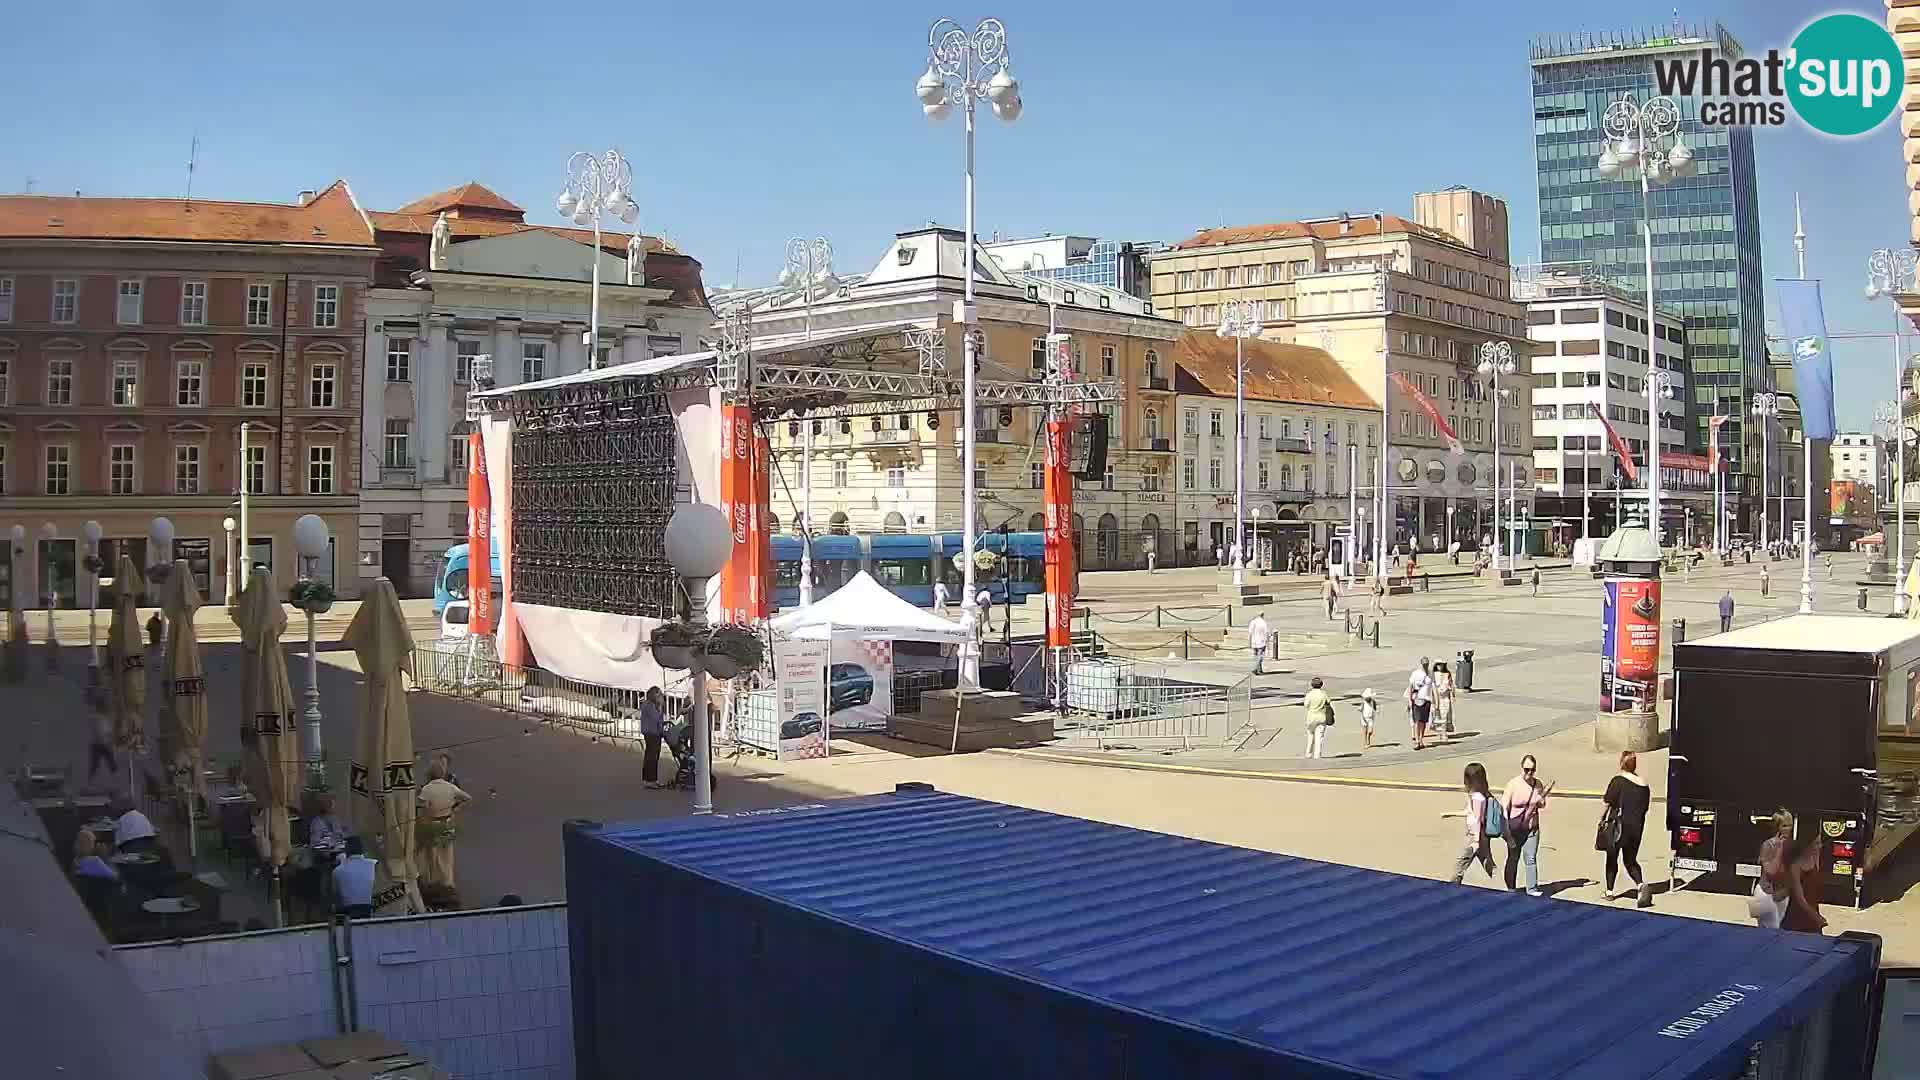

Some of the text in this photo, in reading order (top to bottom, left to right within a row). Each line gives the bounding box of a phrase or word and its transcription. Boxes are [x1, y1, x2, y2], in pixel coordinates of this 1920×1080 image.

[734, 416, 748, 459] Coca-Cola
[733, 498, 747, 543] Coca-Cola
[1690, 989, 1745, 1019] 300629
[1736, 983, 1760, 991] 6
